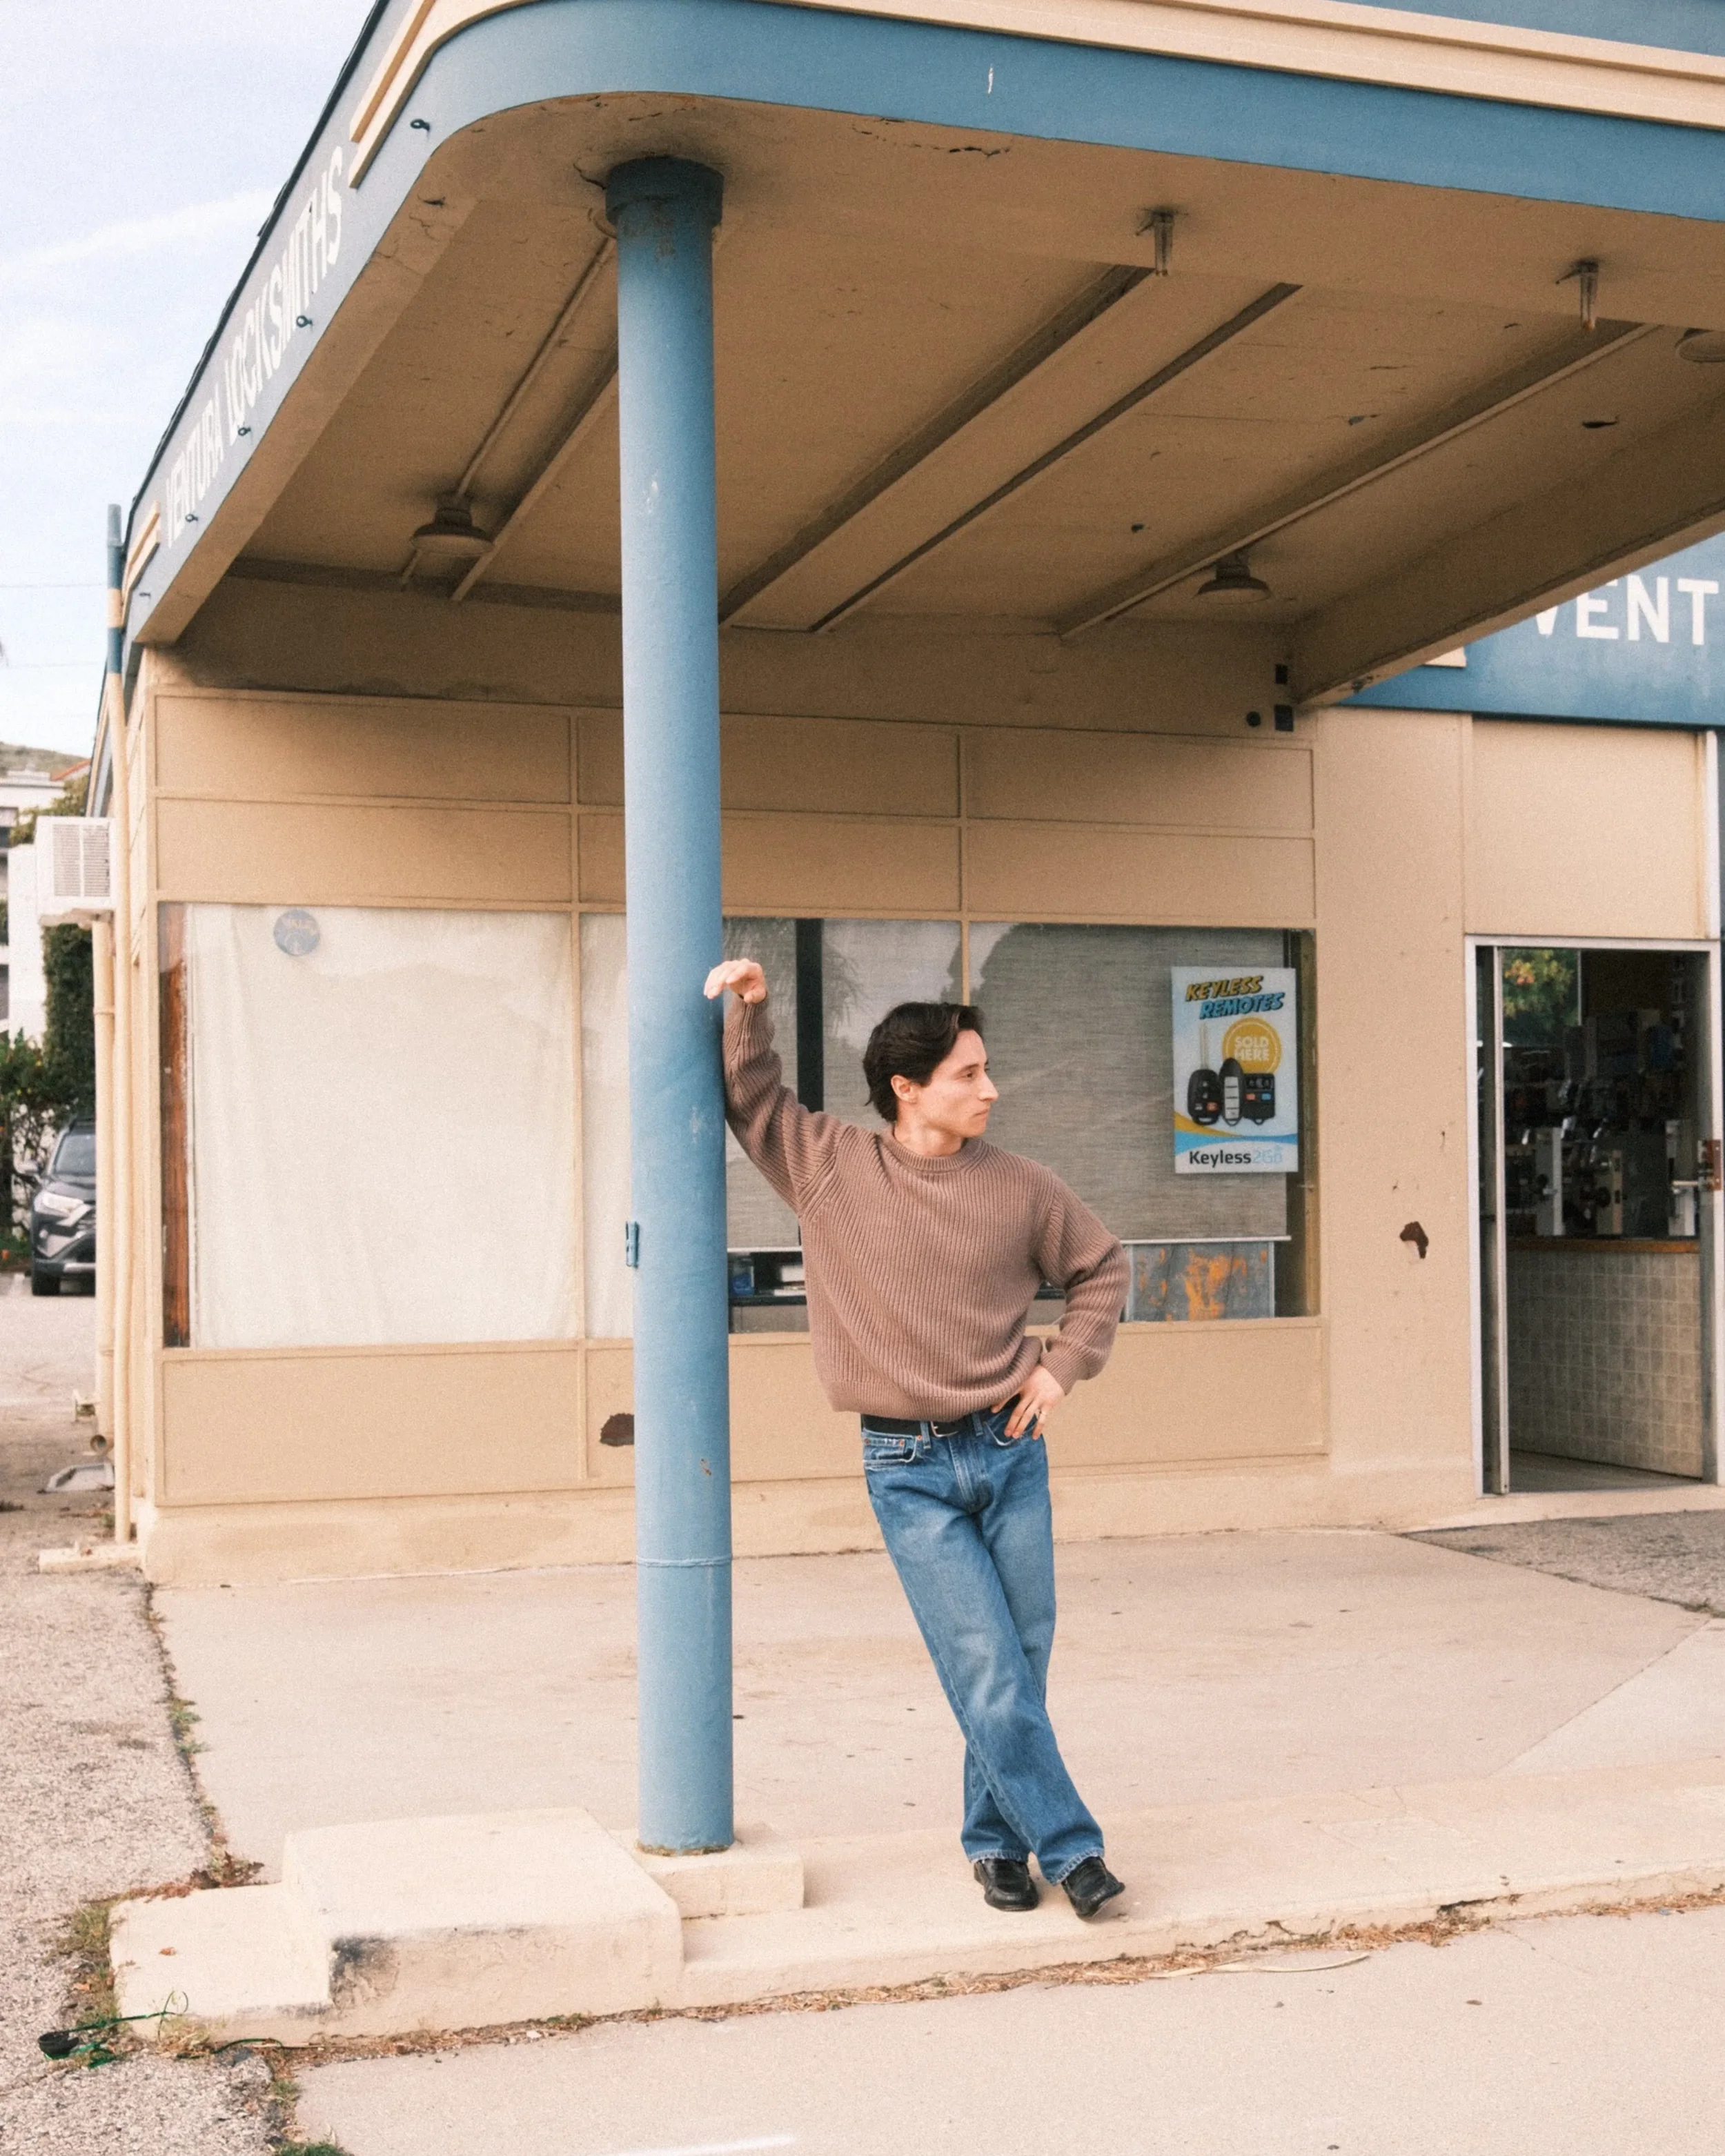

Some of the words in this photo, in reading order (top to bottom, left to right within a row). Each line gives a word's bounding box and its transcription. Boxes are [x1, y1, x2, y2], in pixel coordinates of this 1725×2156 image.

[166, 384, 224, 548] VENTURA
[225, 146, 342, 446] LOCKSMITHS
[1185, 976, 1263, 1001] KEYLESS
[1199, 992, 1285, 1019] REMOTES
[1234, 1036, 1269, 1048] SOLD
[1234, 1047, 1270, 1061] HERE
